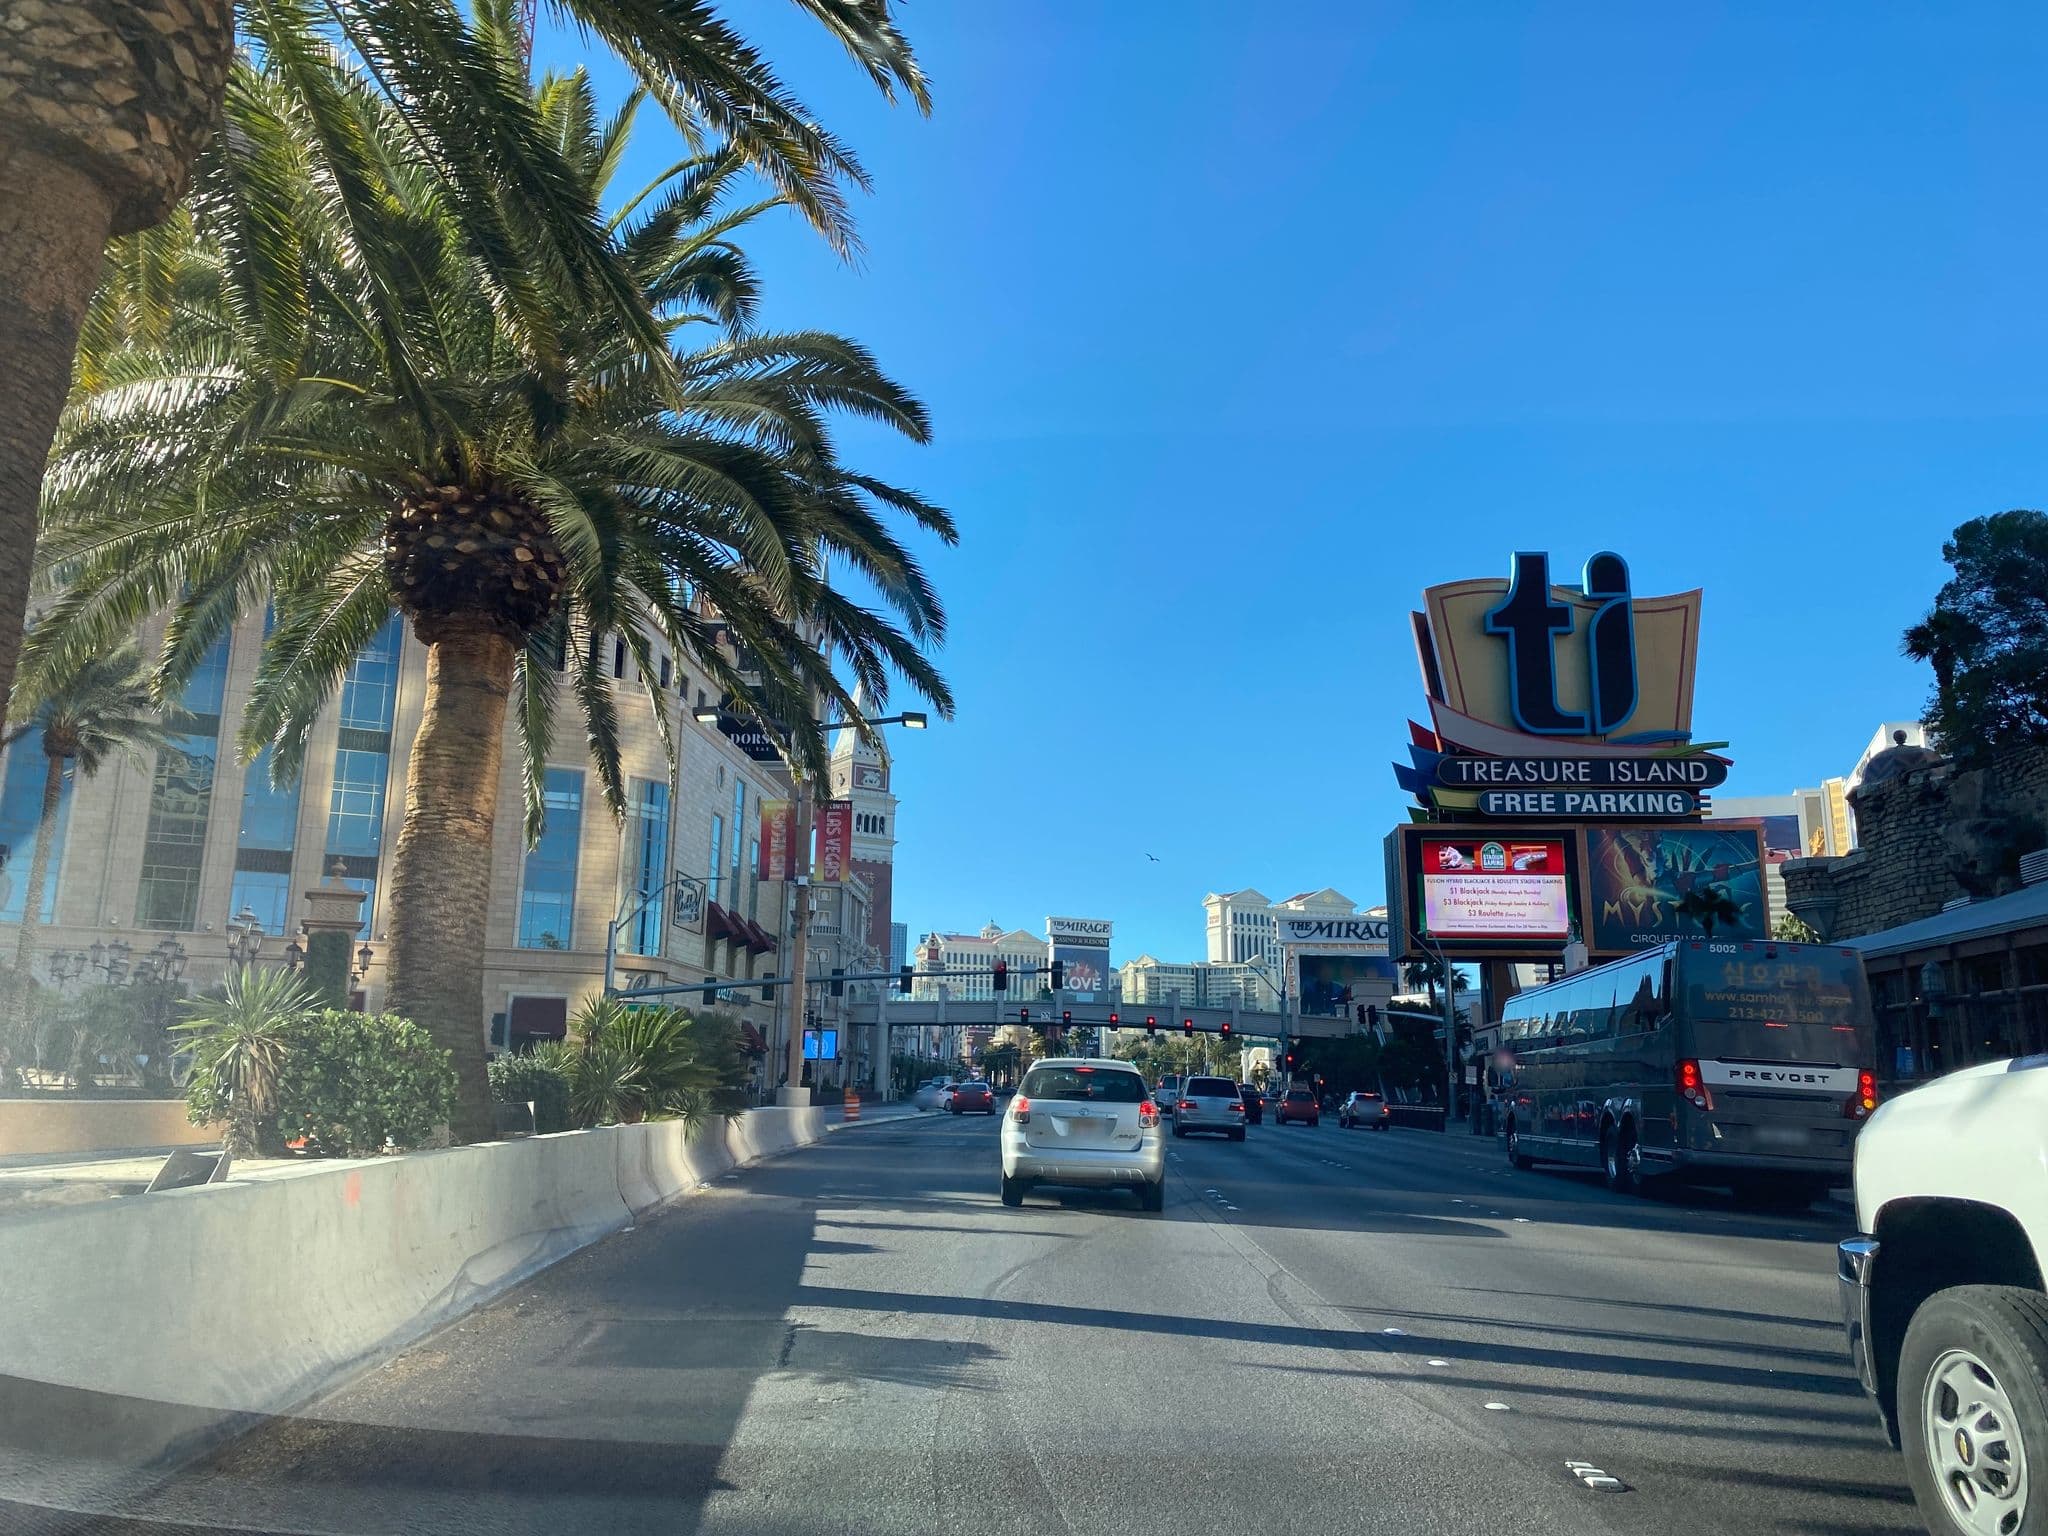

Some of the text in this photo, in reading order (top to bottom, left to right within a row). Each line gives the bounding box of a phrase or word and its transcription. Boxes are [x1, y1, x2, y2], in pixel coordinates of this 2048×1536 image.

[1484, 551, 1639, 735] ti
[730, 733, 786, 745] DORS
[1457, 761, 1708, 782] TREASURE ISLAND
[1489, 793, 1683, 814] FREE PARKING
[825, 812, 841, 878] LAS VEGAS
[1460, 887, 1490, 896] Blackjack
[1453, 898, 1484, 907] Blackjack
[1478, 909, 1504, 917] Roulette
[1602, 899, 1753, 928] MYSTE
[1057, 921, 1110, 933] MIRAGE
[1288, 922, 1388, 940] THE MIRAG
[1055, 936, 1077, 944] CASINO
[1085, 937, 1108, 945] RESORT
[1631, 934, 1671, 944] CIRQUE
[1710, 944, 1737, 954] 5002
[1062, 976, 1102, 991] LOVE
[1729, 1070, 1830, 1084] PREVOST
